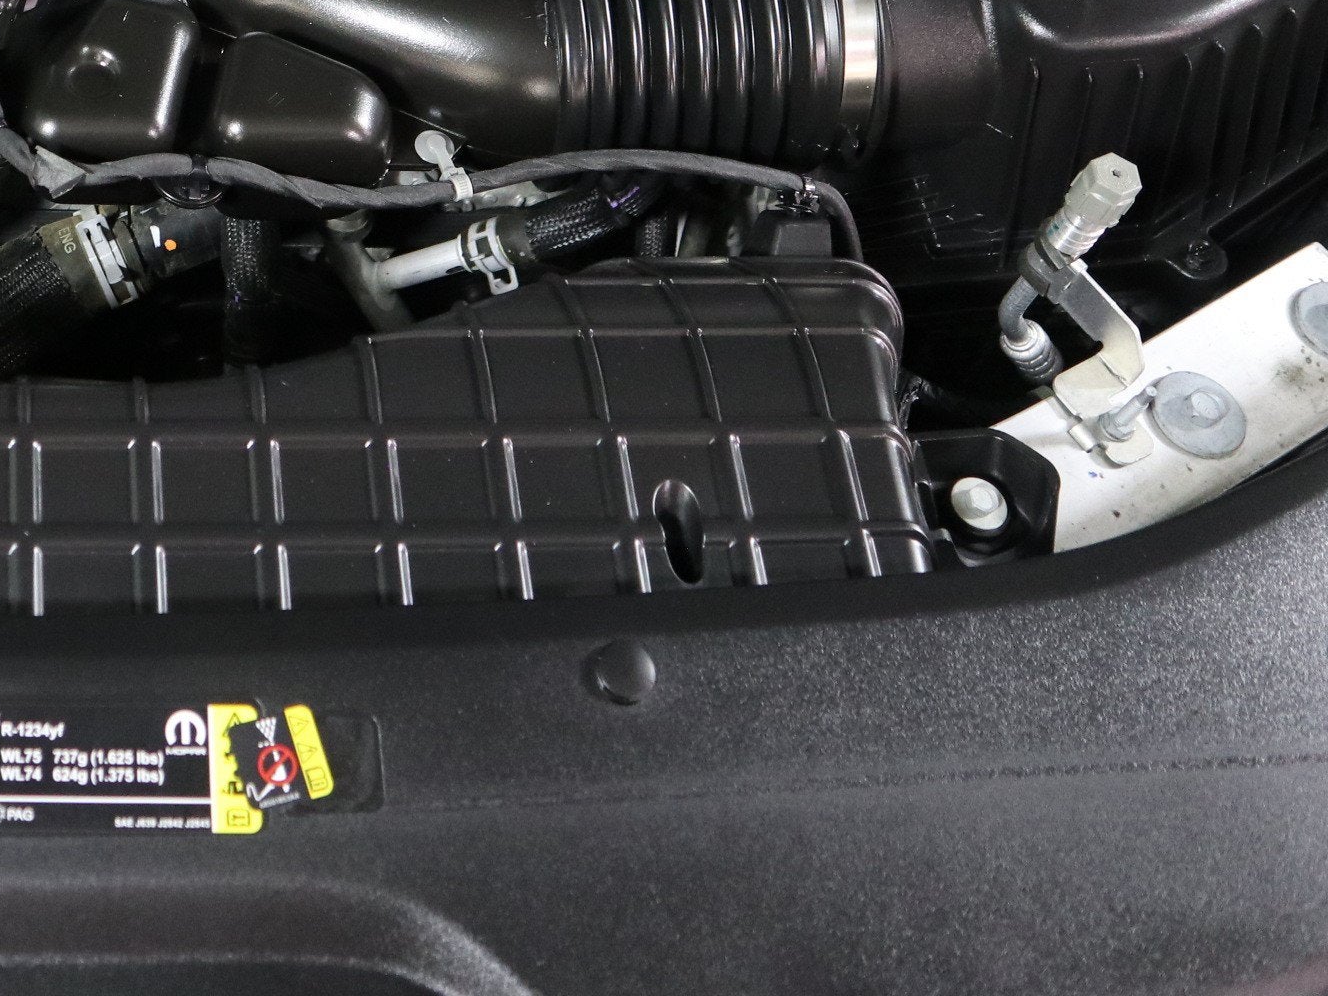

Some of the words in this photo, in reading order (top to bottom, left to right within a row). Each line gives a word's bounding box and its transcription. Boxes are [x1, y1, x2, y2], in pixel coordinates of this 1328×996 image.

[58, 227, 77, 254] ENG
[0, 720, 66, 741] R-1234yf
[0, 747, 43, 764] WL75
[52, 748, 88, 767] 737g
[90, 747, 135, 768] (1.625
[136, 748, 165, 768] lbs)
[0, 764, 43, 782] WL74
[52, 765, 89, 786] 624g
[90, 766, 135, 786] (1.375
[136, 766, 165, 786] lbs)
[7, 806, 35, 822] PAG
